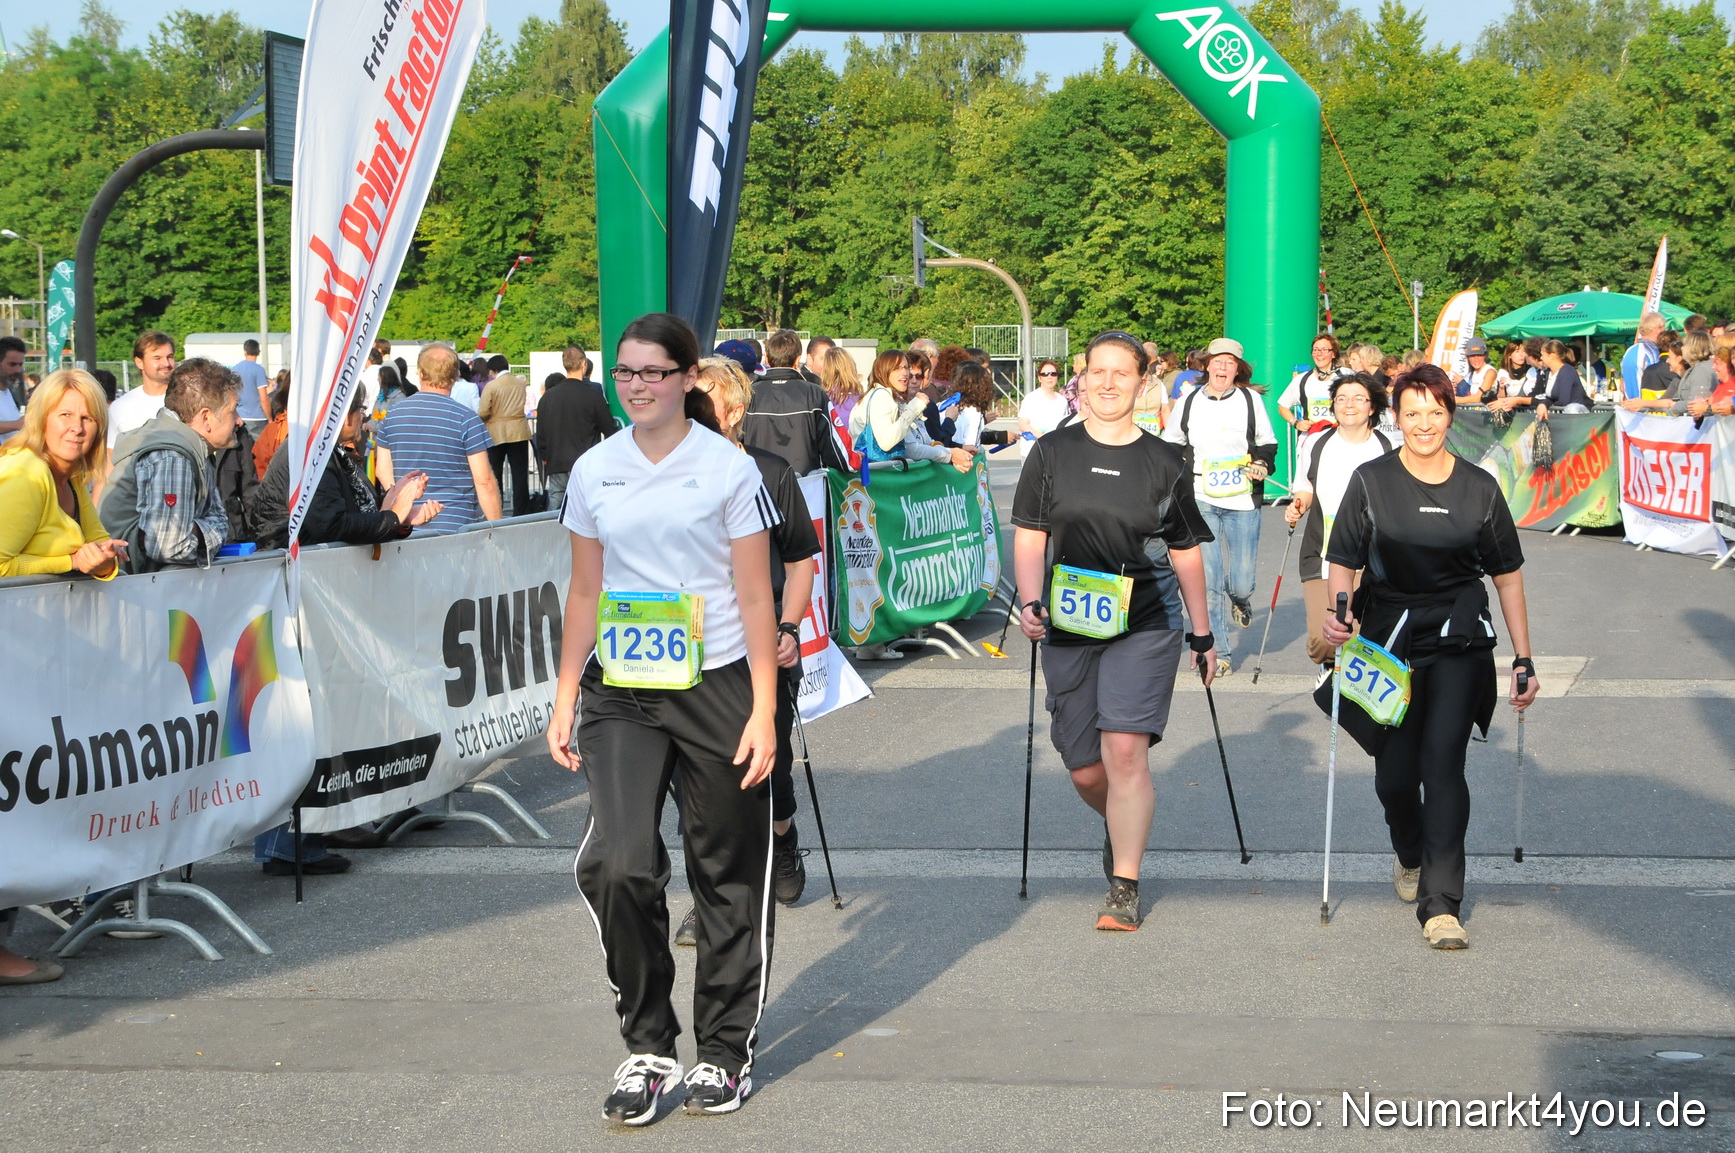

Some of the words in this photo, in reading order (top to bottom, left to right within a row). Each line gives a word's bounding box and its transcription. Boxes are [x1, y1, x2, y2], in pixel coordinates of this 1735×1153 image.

[1155, 6, 1289, 120] AOK
[338, 118, 407, 265] Print
[1208, 469, 1242, 487] 328
[1627, 442, 1705, 517] MEIER
[899, 484, 970, 541] Neumarkter
[887, 532, 985, 612] Lammsbräu
[1060, 589, 1112, 623] 516
[1069, 616, 1091, 626] Sabine
[442, 581, 563, 708] swn
[602, 626, 687, 662] 1236
[623, 664, 655, 673] Daniela
[1345, 656, 1398, 703] 517
[454, 701, 544, 759] stadtwerke
[355, 764, 376, 784] die
[379, 753, 427, 780] verbinden
[88, 801, 160, 842] Druck
[170, 795, 181, 822] &
[186, 778, 262, 816] Medien
